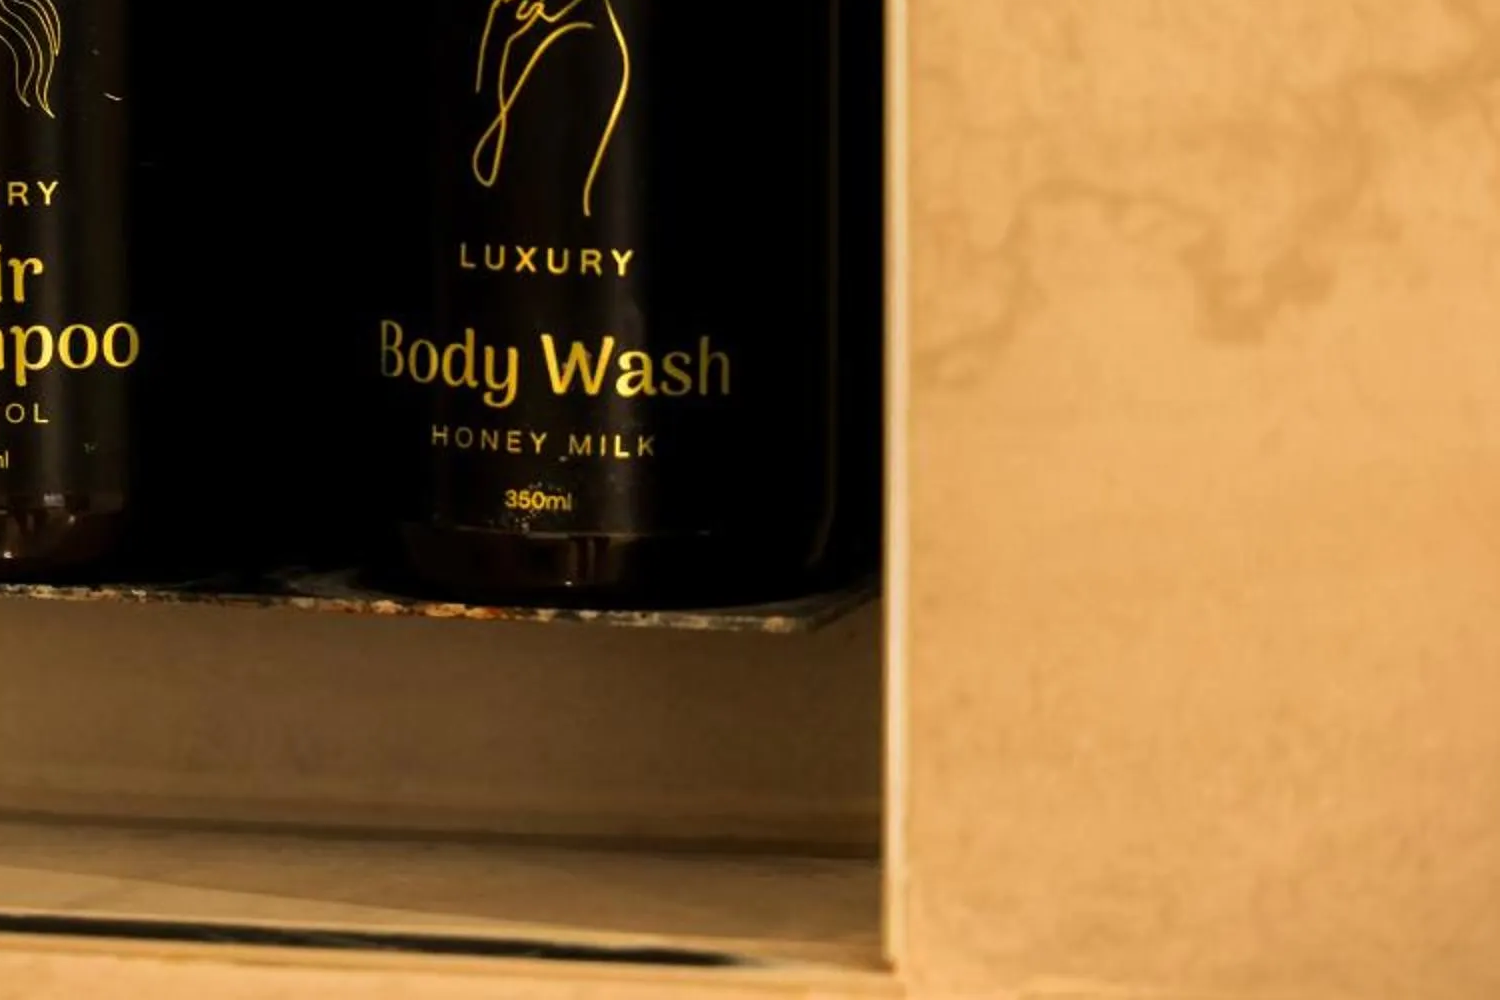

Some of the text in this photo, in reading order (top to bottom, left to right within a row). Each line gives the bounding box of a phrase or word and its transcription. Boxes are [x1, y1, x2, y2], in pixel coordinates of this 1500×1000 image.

[459, 242, 634, 277] LUXURY
[381, 319, 731, 408] Body Wash
[431, 424, 656, 458] HONEY MILK
[504, 489, 572, 511] 350ml
